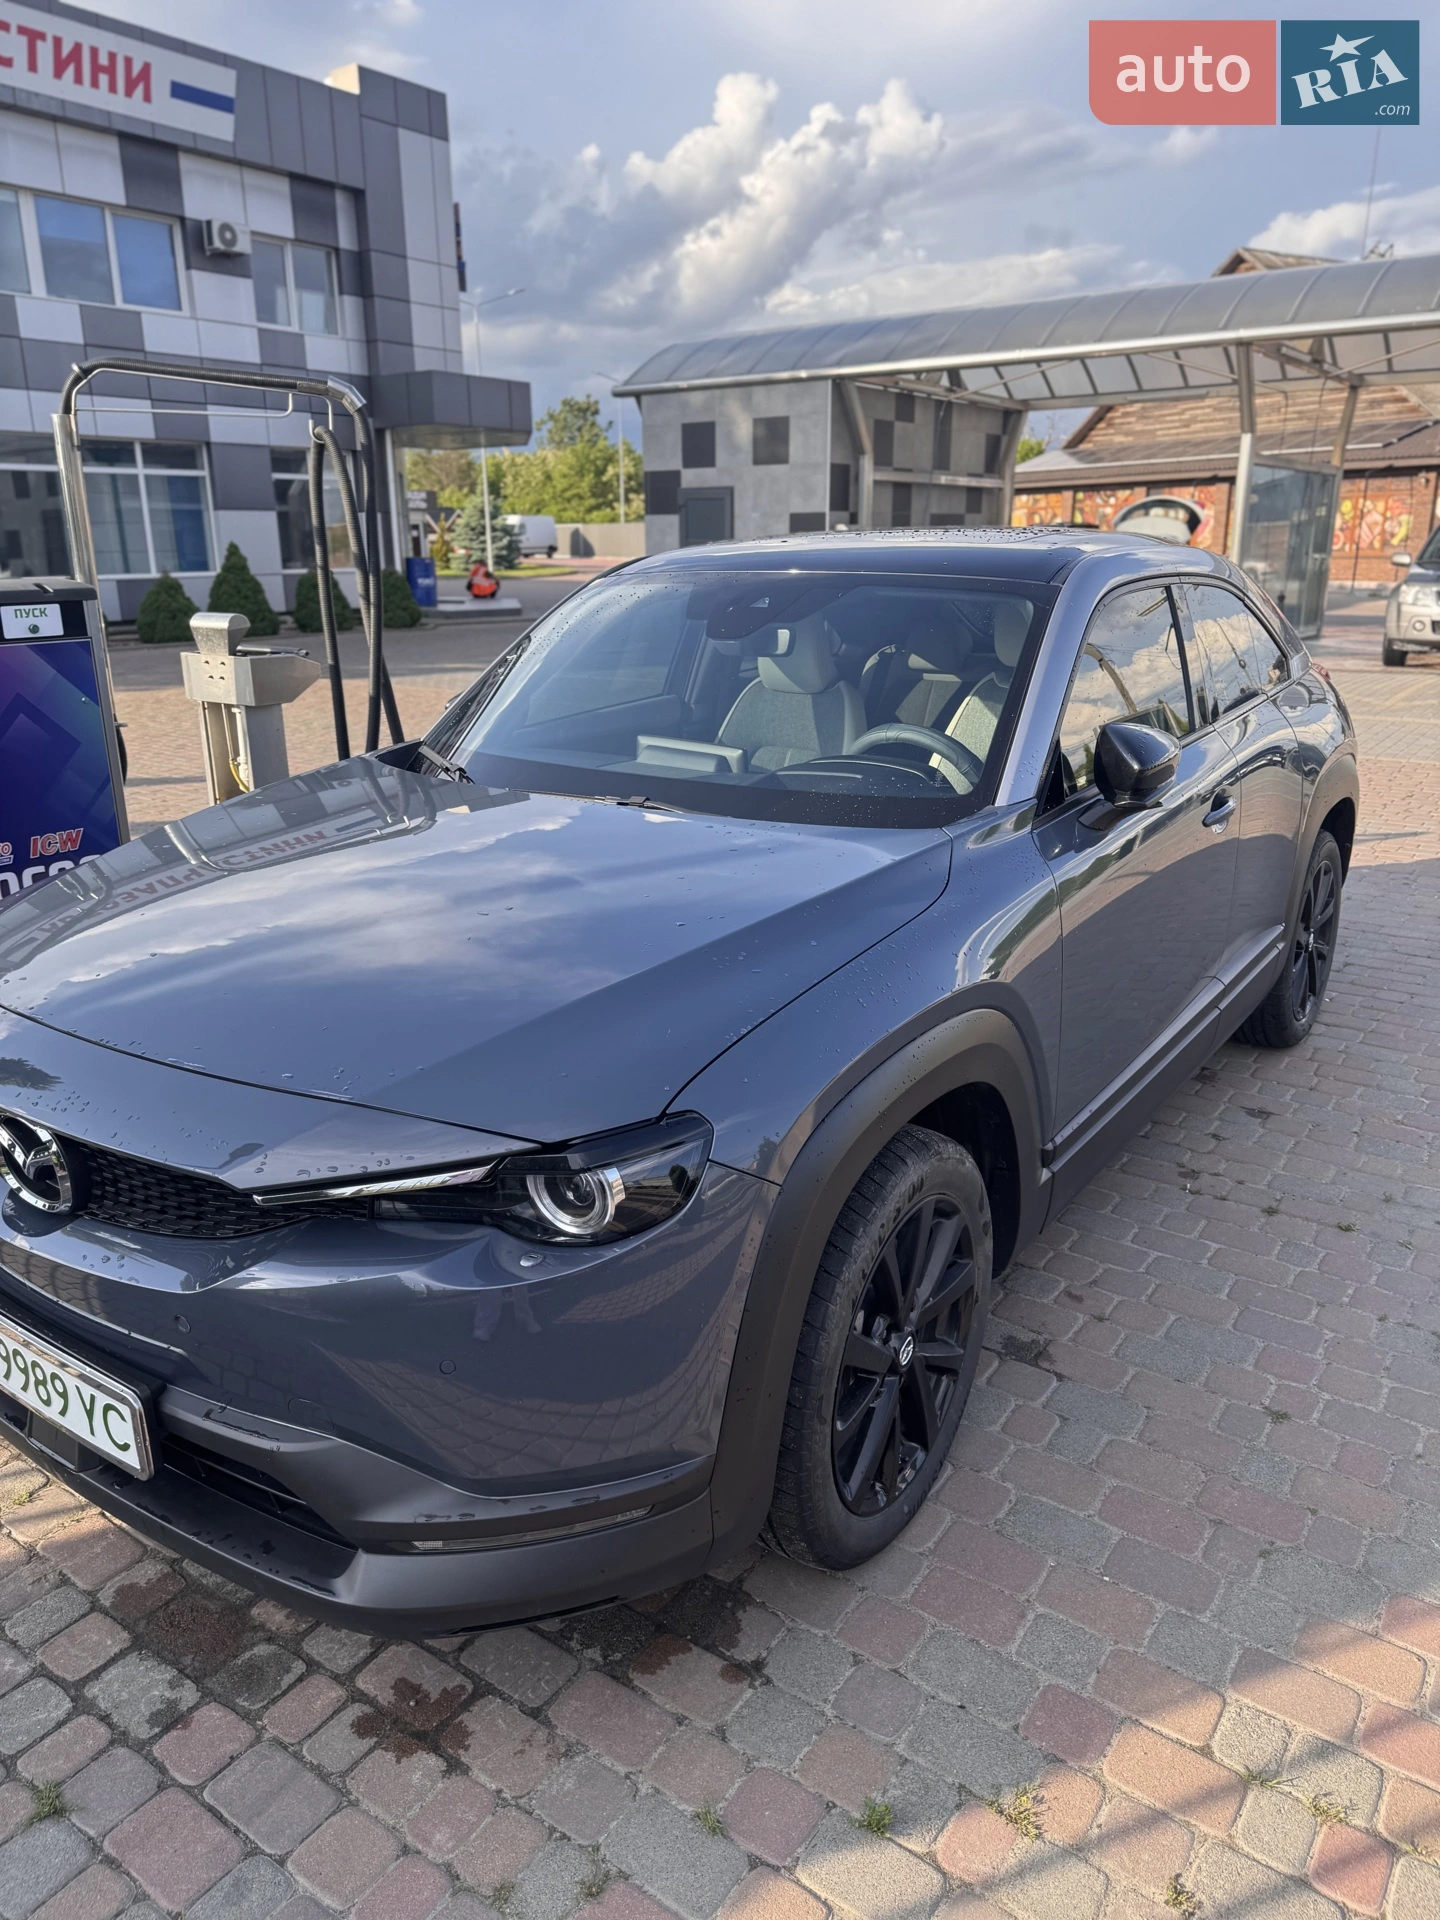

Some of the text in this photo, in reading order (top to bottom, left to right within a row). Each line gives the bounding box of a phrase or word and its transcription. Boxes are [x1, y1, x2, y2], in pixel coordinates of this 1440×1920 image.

[14, 607, 49, 619] ПУСК
[30, 828, 84, 859] ICW
[75, 1384, 131, 1453] YC
